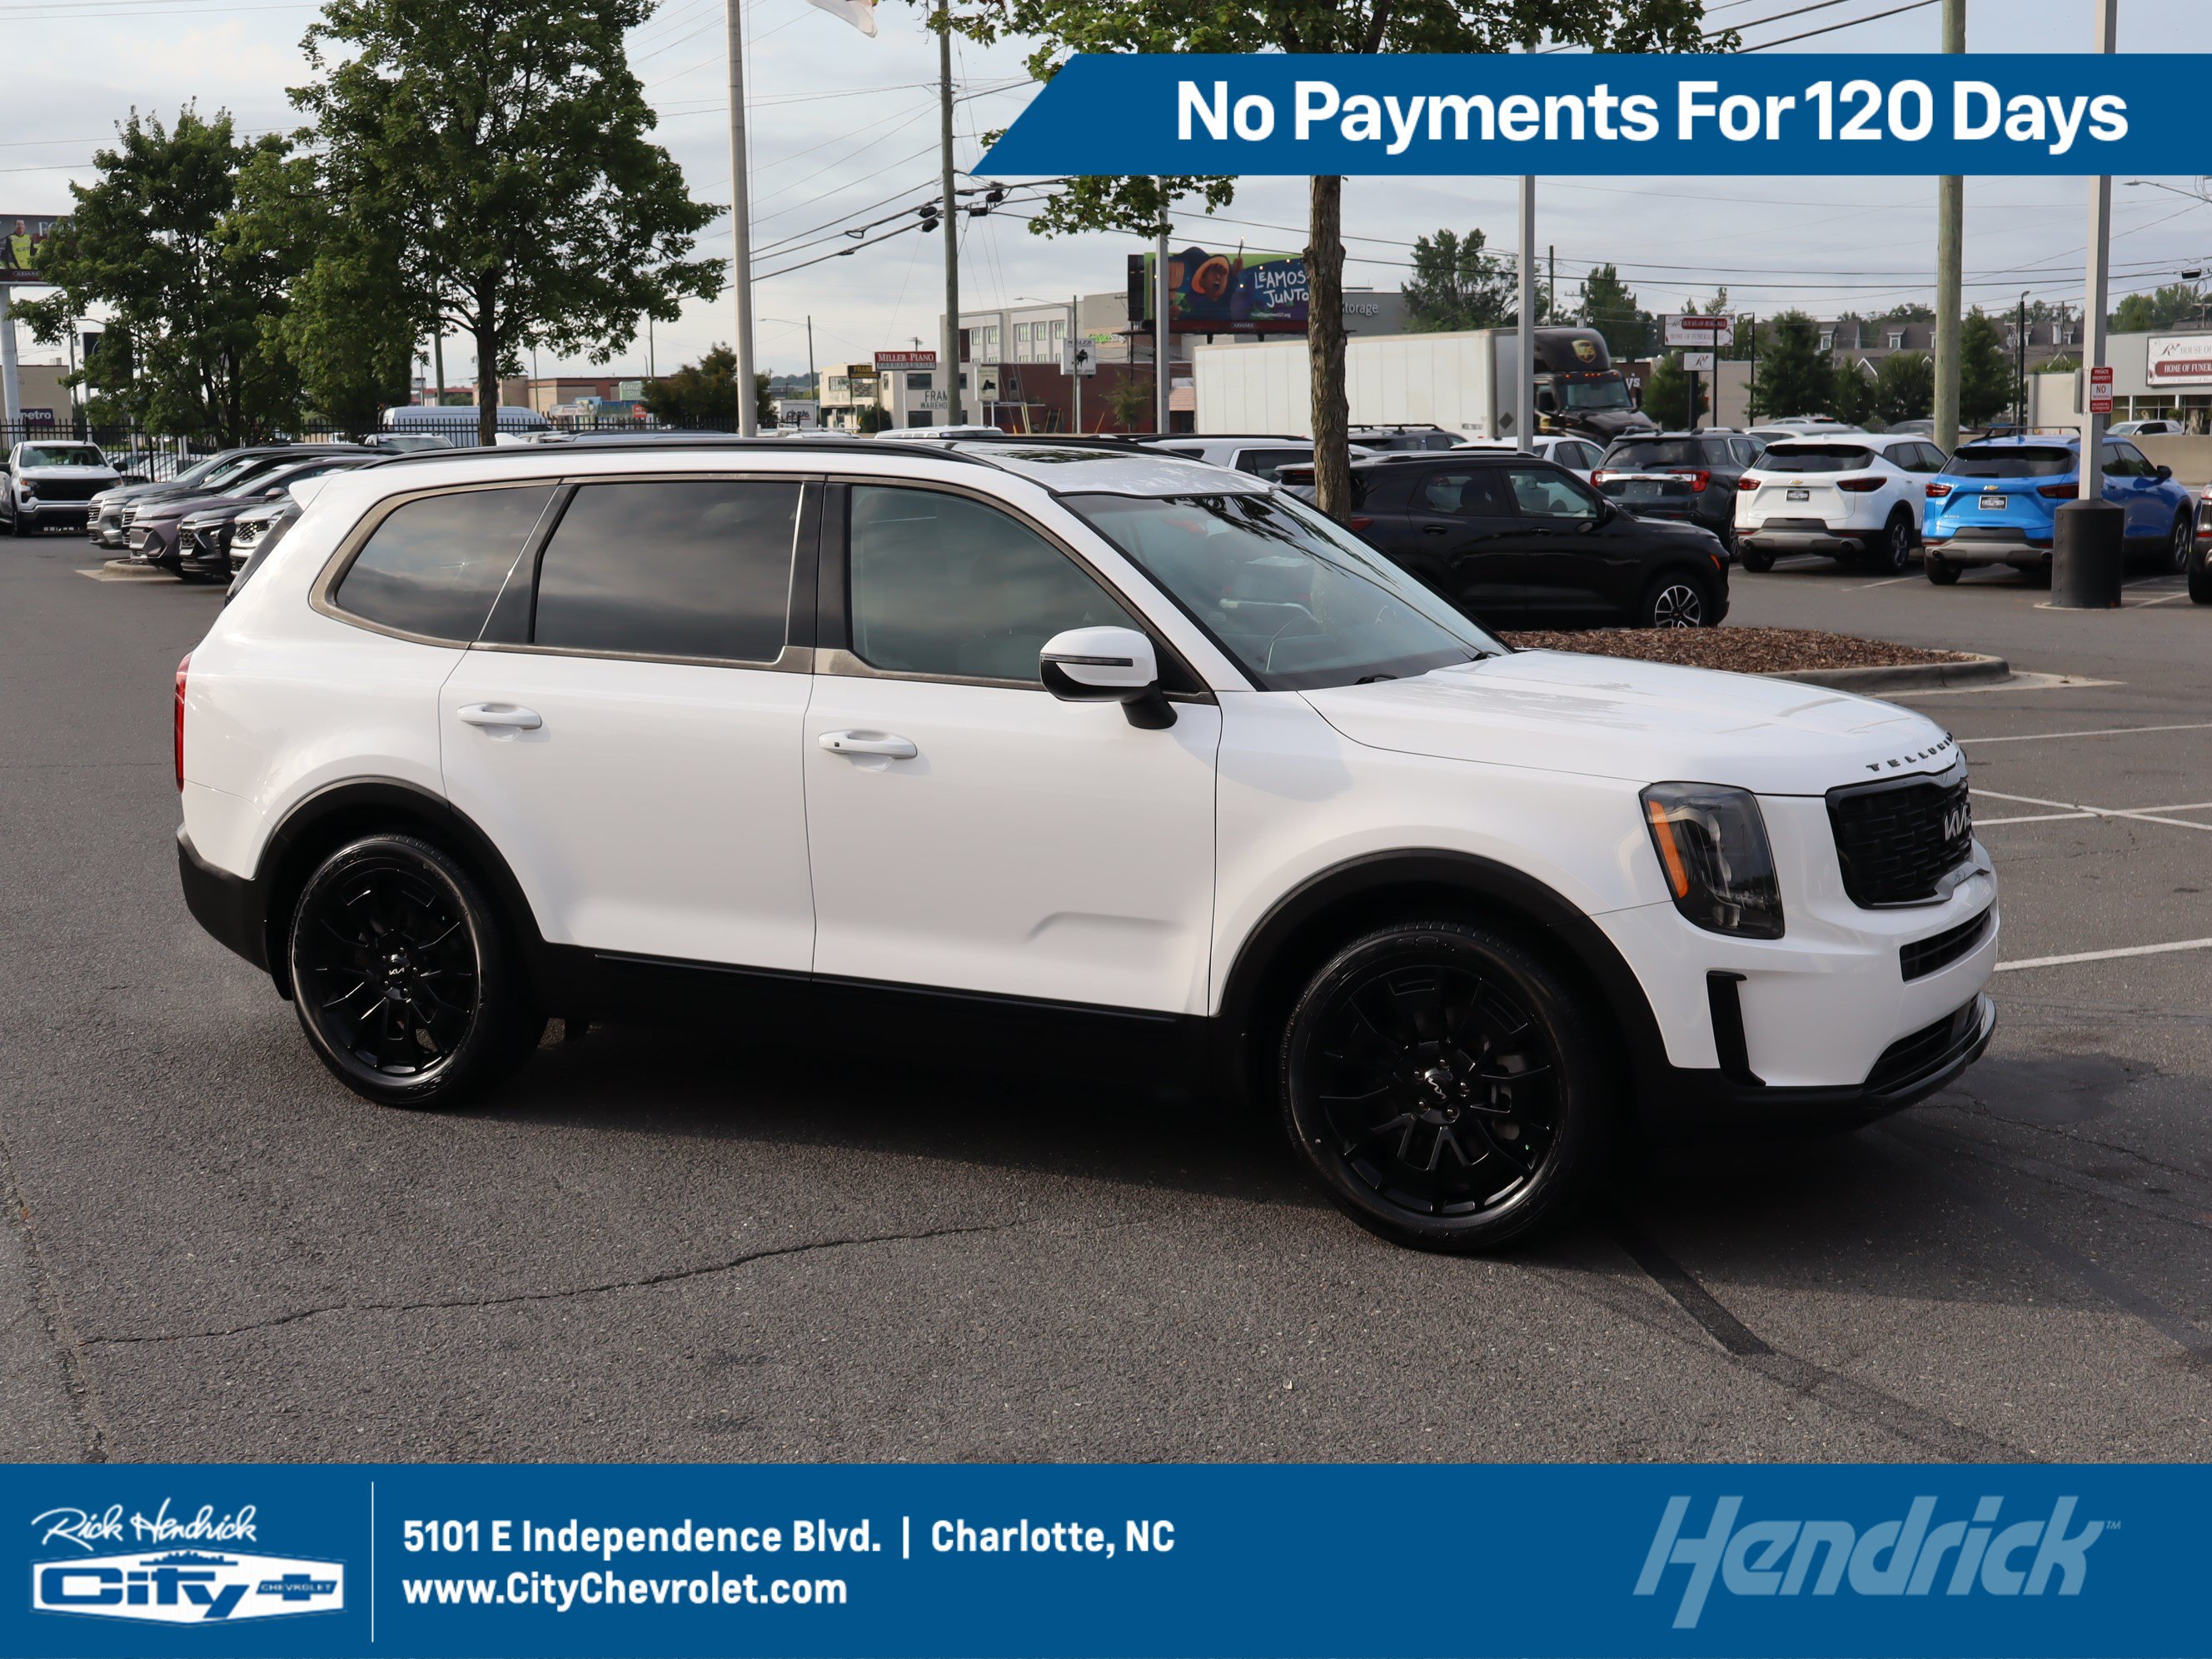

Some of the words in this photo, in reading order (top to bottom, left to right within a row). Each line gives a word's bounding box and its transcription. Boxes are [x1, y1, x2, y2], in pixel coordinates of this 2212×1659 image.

[1254, 271, 1307, 289] LEAMOS
[2180, 346, 2203, 355] HOUSE
[879, 353, 907, 362] MILLER
[909, 352, 934, 361] PIANO
[2165, 364, 2181, 372] HOME
[2182, 364, 2191, 372] OF
[2191, 363, 2212, 372] FUNER
[2096, 385, 2107, 394] NO
